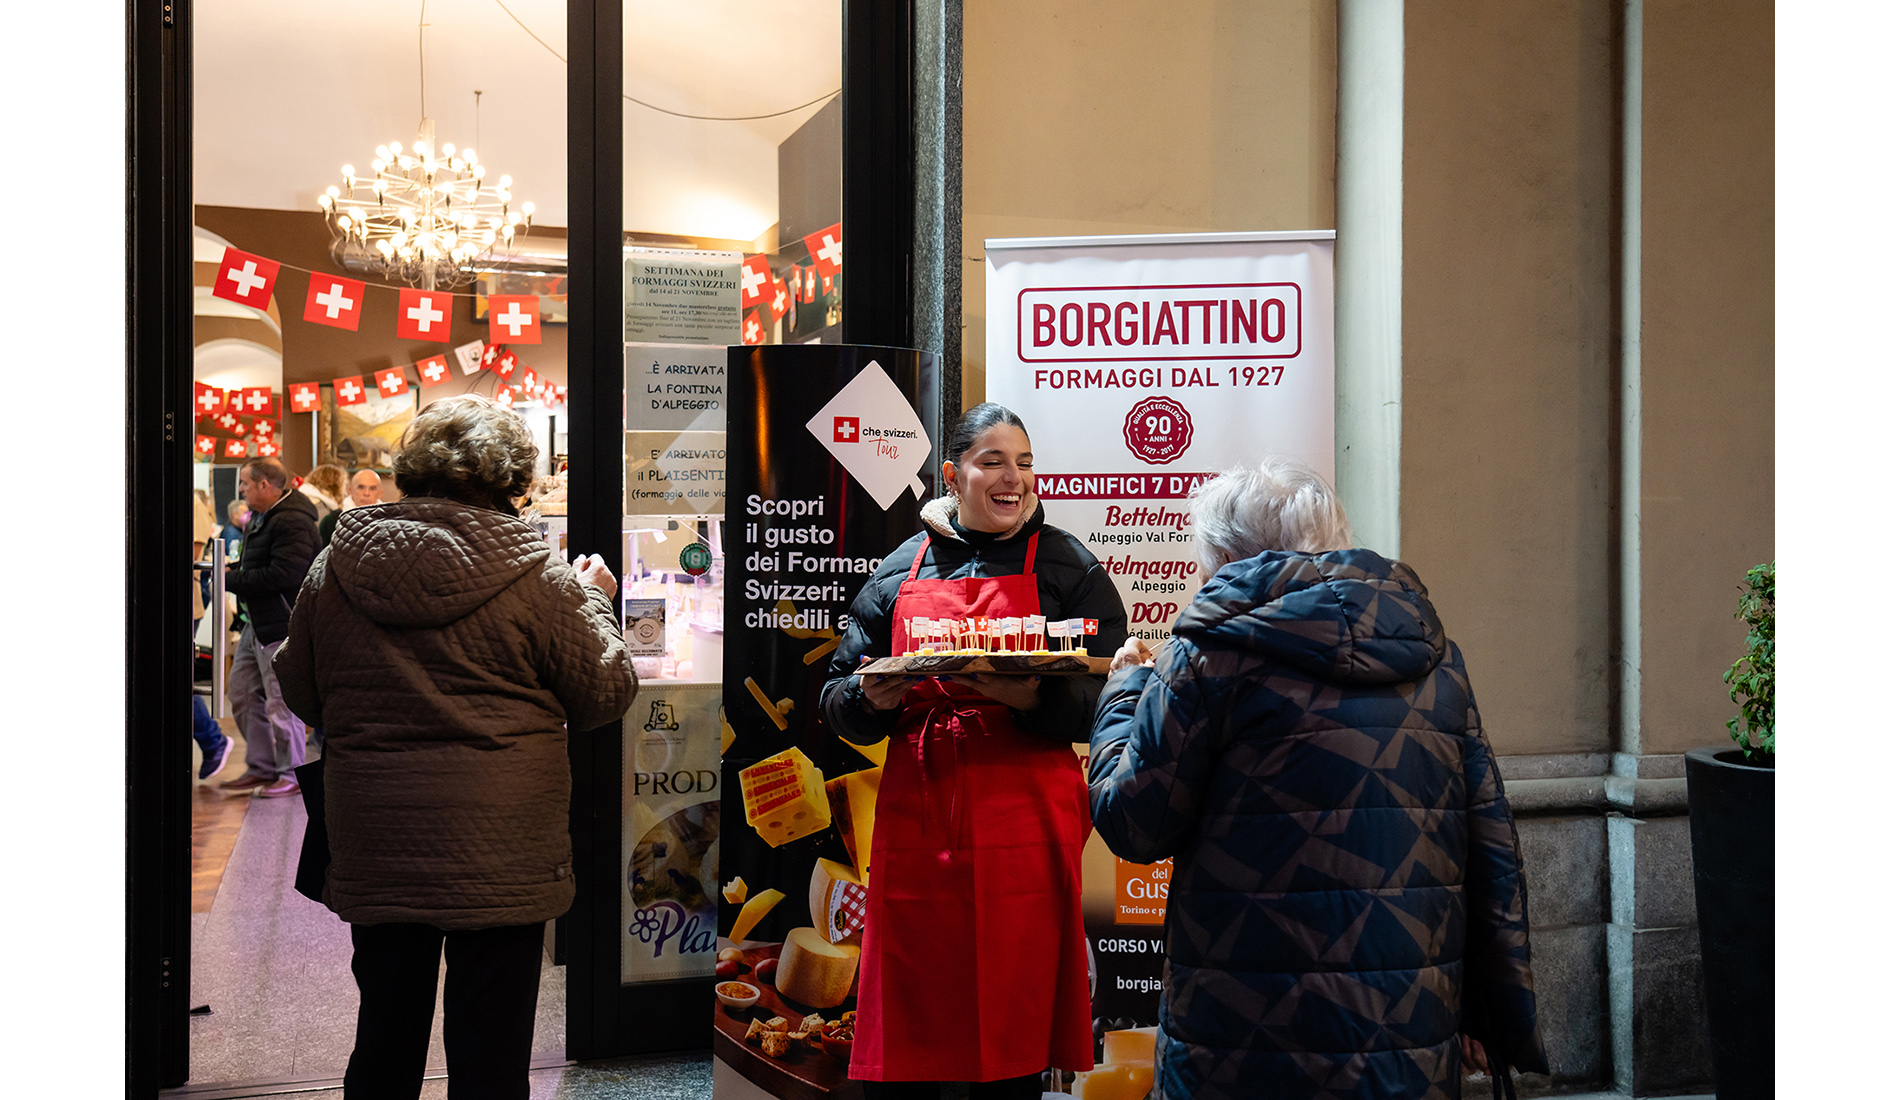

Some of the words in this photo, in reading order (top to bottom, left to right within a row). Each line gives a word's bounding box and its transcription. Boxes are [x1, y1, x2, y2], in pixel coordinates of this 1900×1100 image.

[644, 266, 704, 277] SETTIMANA
[706, 270, 724, 278] DEI
[632, 277, 687, 287] FORMAGGI
[690, 280, 736, 289] SVIZZERI
[1032, 298, 1286, 347] BORGIATTINO
[665, 365, 724, 375] ARRIVATA
[1035, 368, 1162, 389] FORMAGGI
[1172, 367, 1219, 387] DAL
[1229, 366, 1285, 387] 1927
[647, 384, 662, 394] LA
[667, 384, 722, 394] FONTINA
[652, 400, 719, 410] D'ALPEGGIO
[1133, 406, 1150, 424] QUALITÀ
[1155, 404, 1184, 424] ECCELLENZA
[1146, 416, 1171, 435] 90
[862, 427, 881, 436] che
[883, 428, 918, 439] svizzeri.
[868, 436, 899, 459] Tour
[1142, 445, 1156, 455] 1927
[1161, 444, 1174, 455] 2017
[666, 450, 726, 459] ARRIVATO
[638, 472, 643, 481] il
[649, 470, 724, 481] PLAISENTI
[1038, 477, 1145, 495] MAGNIFICI
[1152, 477, 1164, 494] 7
[632, 489, 683, 500] (formaggio
[687, 489, 709, 497] delle
[746, 494, 824, 520] Scopri
[746, 523, 758, 543] il
[765, 525, 834, 548] gusto
[1088, 532, 1143, 545] Alpeggio
[1146, 532, 1164, 542] Val
[746, 552, 779, 572] dei
[745, 579, 845, 601] Svizzeri:
[1131, 581, 1186, 593] Alpeggio
[745, 608, 829, 629] chiedili
[838, 614, 848, 630] a
[1131, 602, 1178, 624] DOP
[1129, 628, 1170, 639] édaille
[633, 770, 717, 795] PROD
[1152, 868, 1167, 879] del
[1126, 878, 1169, 899] Gus
[1120, 905, 1150, 914] Torino
[1098, 939, 1147, 953] CORSO
